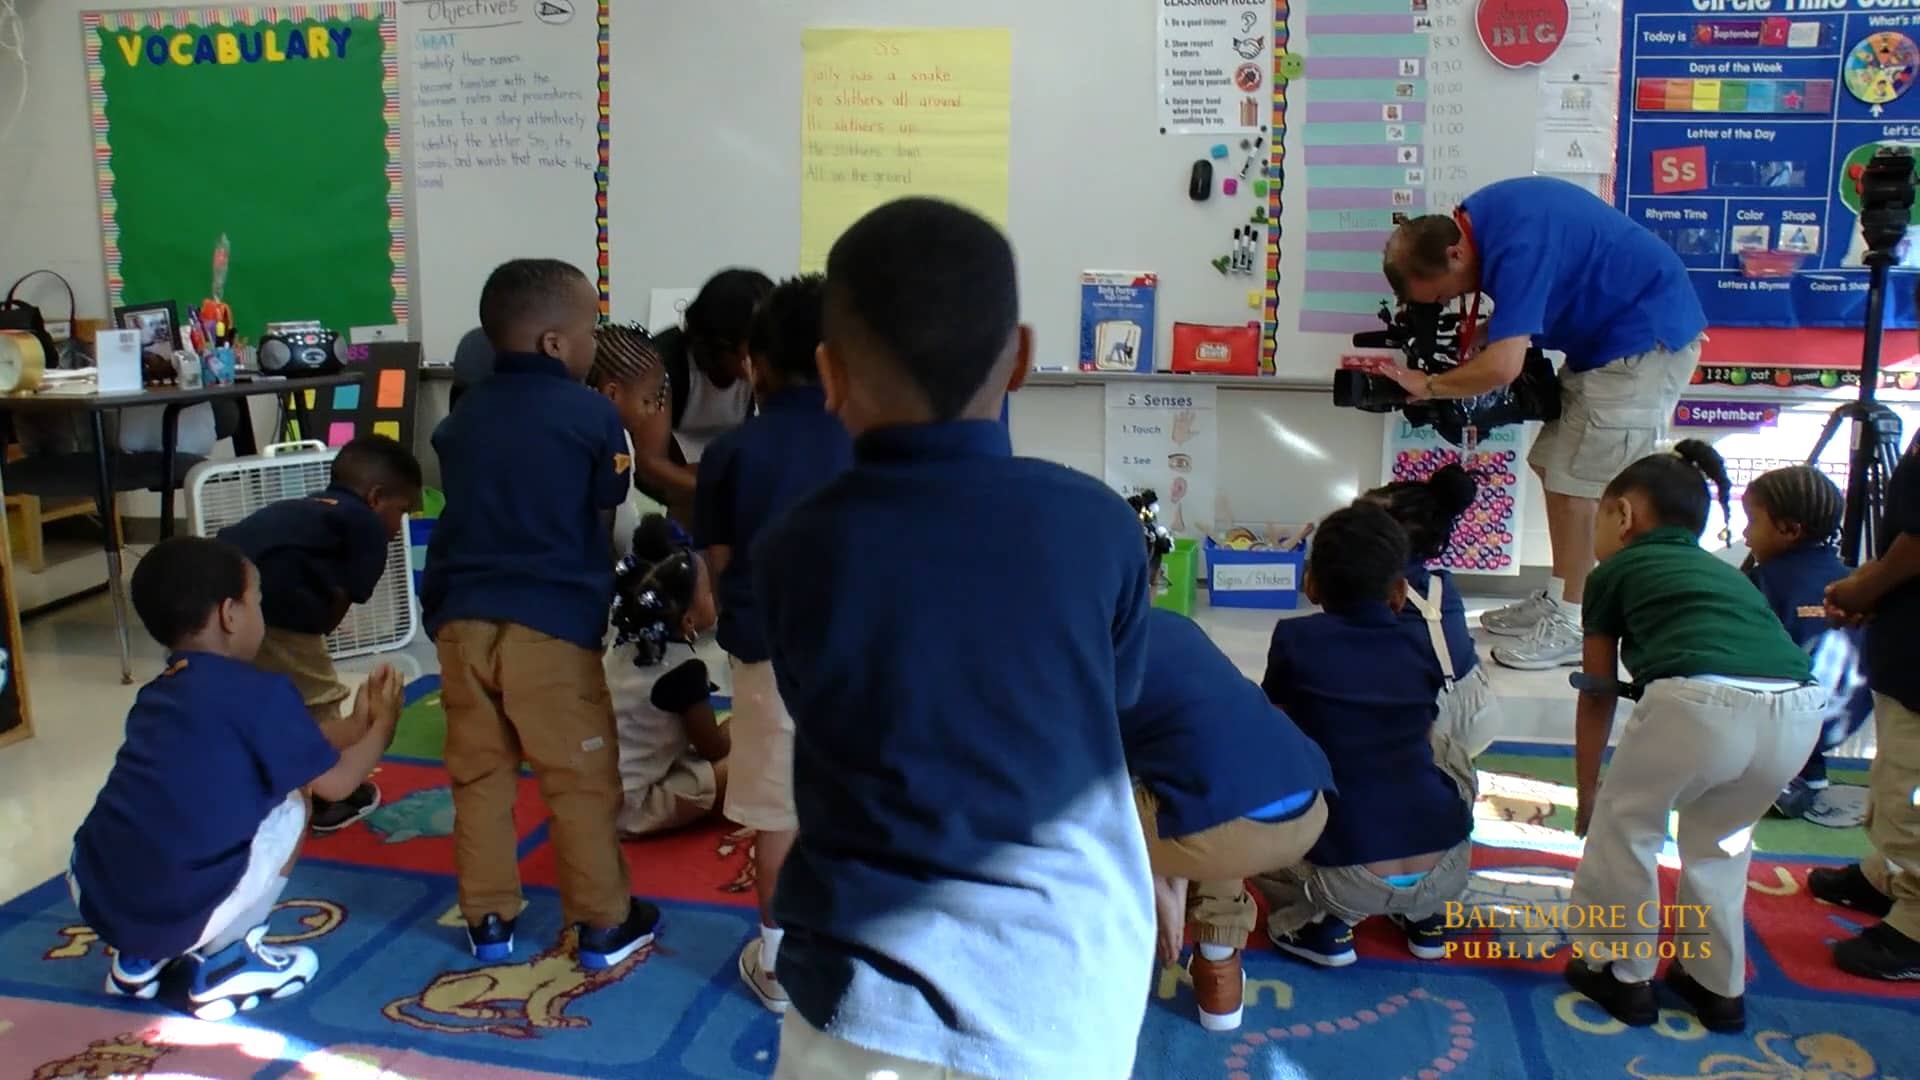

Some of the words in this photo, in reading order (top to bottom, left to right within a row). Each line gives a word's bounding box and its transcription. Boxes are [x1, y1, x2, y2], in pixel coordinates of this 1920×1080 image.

[427, 0, 519, 23] Objectives
[1869, 15, 1909, 26] What's
[1492, 23, 1557, 47] BIG
[1643, 31, 1675, 44] Today
[1677, 32, 1687, 42] is
[117, 26, 352, 67] VOCABULARY
[911, 65, 952, 83] snake
[1689, 62, 1716, 74] Days
[1718, 62, 1731, 73] of
[1733, 62, 1750, 73] the
[1752, 62, 1784, 73] Week
[919, 94, 962, 108] around
[1687, 128, 1719, 140] Letter
[1720, 128, 1734, 140] of
[1736, 128, 1751, 140] the
[1753, 128, 1776, 142] Day
[1662, 156, 1696, 183] Ss
[1645, 208, 1681, 222] Rhyme
[1684, 208, 1708, 221] Time
[1737, 209, 1764, 221] Color
[1782, 210, 1816, 223] Shape
[1718, 280, 1748, 291] Letters
[1758, 281, 1791, 292] Rhymes
[1810, 282, 1838, 292] Colors
[1751, 370, 1770, 381] cat
[1127, 394, 1137, 406] 5
[1144, 394, 1193, 407] Senses
[1692, 406, 1764, 423] September
[1132, 424, 1161, 435] Touch
[1133, 456, 1152, 465] See
